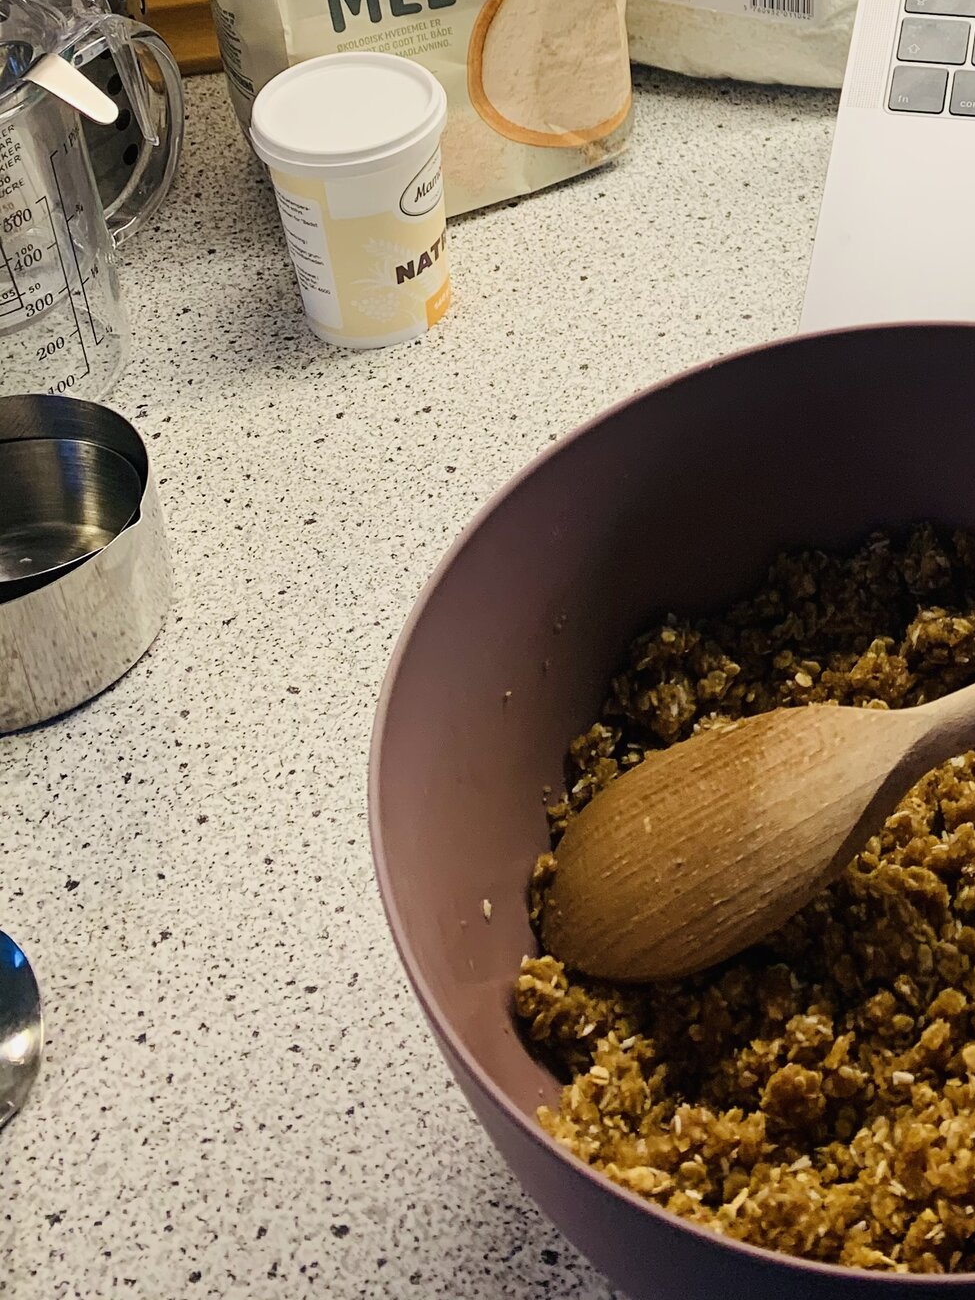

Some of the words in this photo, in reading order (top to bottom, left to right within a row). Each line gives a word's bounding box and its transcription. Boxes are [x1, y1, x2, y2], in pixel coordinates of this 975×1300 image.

[336, 32, 384, 53] ØKOLOGISK
[384, 22, 428, 40] HVEDEMEL
[430, 18, 442, 28] ER
[392, 37, 414, 49] GODT
[416, 33, 429, 44] TIL
[430, 26, 454, 39] BÅDE
[897, 94, 909, 104] fn
[13, 248, 43, 273] 400
[15, 243, 34, 259] 100
[28, 282, 41, 294] 50
[25, 292, 54, 318] 300
[36, 336, 65, 362] 200
[49, 374, 75, 395] 100
